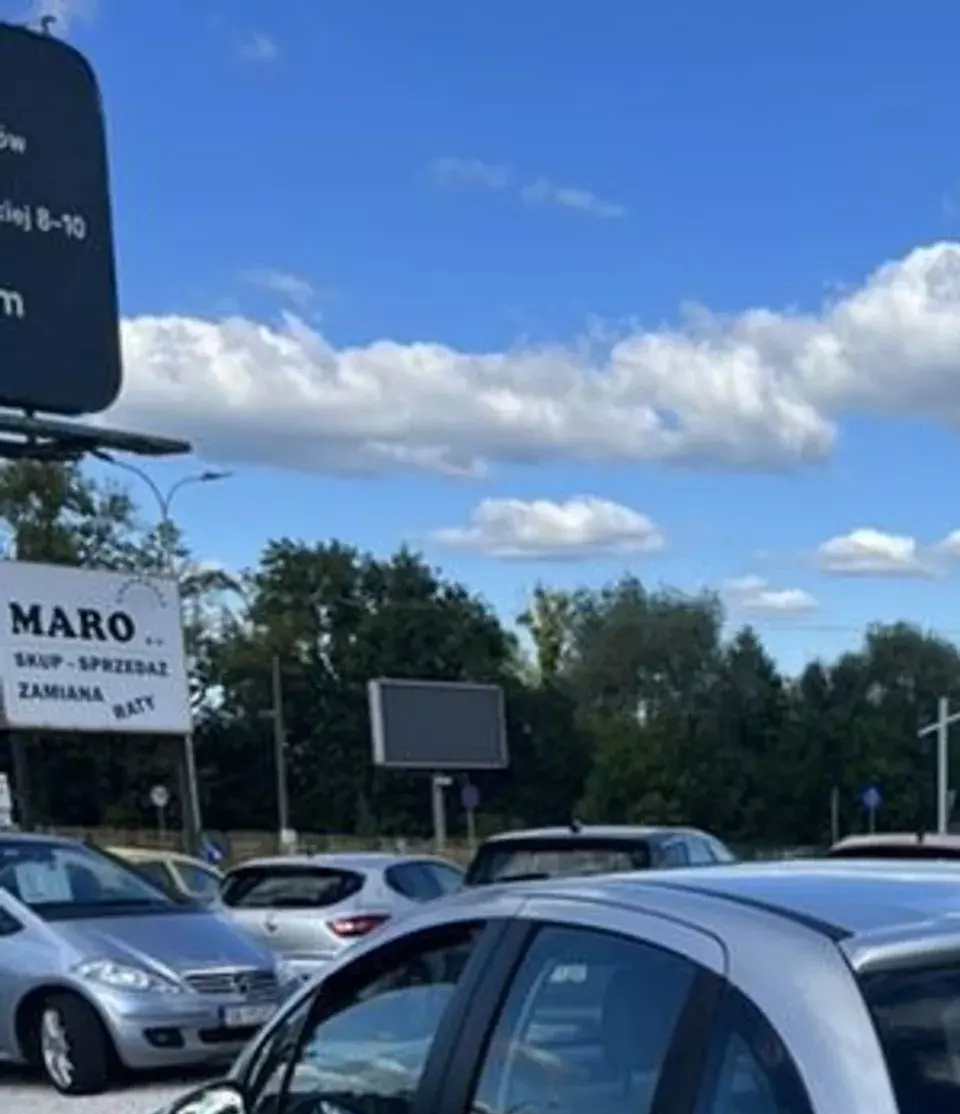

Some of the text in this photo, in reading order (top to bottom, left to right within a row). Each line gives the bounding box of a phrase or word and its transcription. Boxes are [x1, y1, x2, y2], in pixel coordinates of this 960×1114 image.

[37, 207, 86, 239] 8-10
[9, 602, 135, 642] MARO
[15, 652, 63, 669] SKUP
[19, 682, 103, 702] ZAMIANA
[112, 695, 155, 718] RATY
